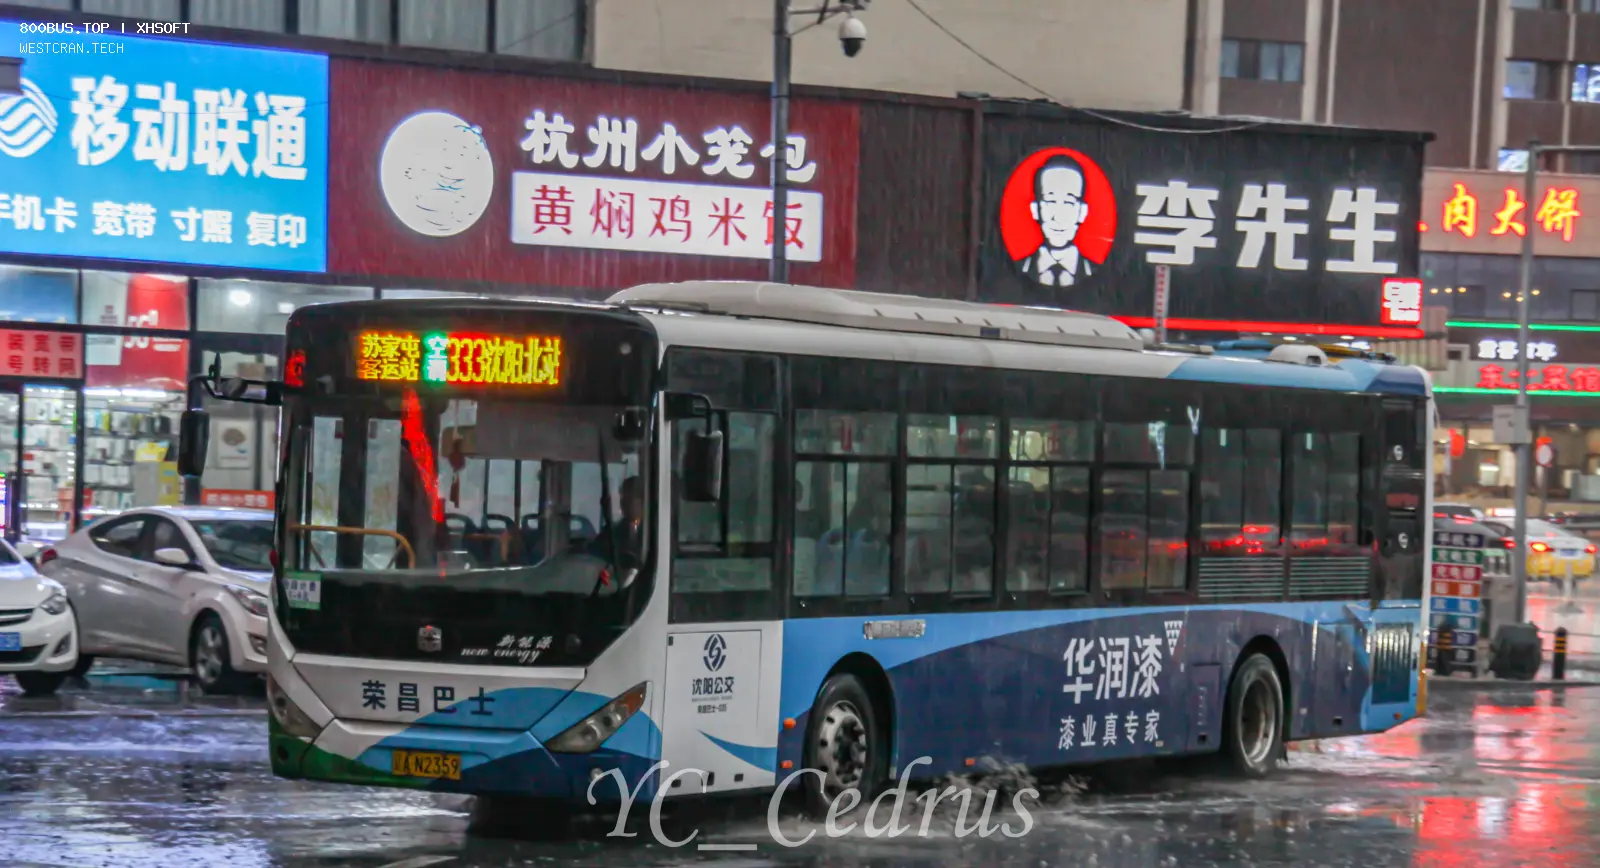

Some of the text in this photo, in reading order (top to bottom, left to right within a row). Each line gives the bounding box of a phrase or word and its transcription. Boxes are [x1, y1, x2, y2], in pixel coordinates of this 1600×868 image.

[70, 75, 308, 181] 移动联通
[519, 110, 817, 183] 杭州小笼包
[92, 201, 157, 238] 宽带
[170, 207, 233, 244] 寸照
[246, 211, 307, 249] 复印
[531, 184, 805, 249] 黄焖鸡米饭
[1134, 180, 1400, 274] 李先生
[1418, 183, 1581, 242] 肉大饼
[363, 333, 421, 359] 苏家屯
[493, 648, 541, 664] energy
[1062, 634, 1163, 704] 华润漆
[361, 679, 496, 716] 荣昌巴士
[692, 676, 734, 695] 沈阳公交
[1058, 709, 1160, 750] 漆业真专家
